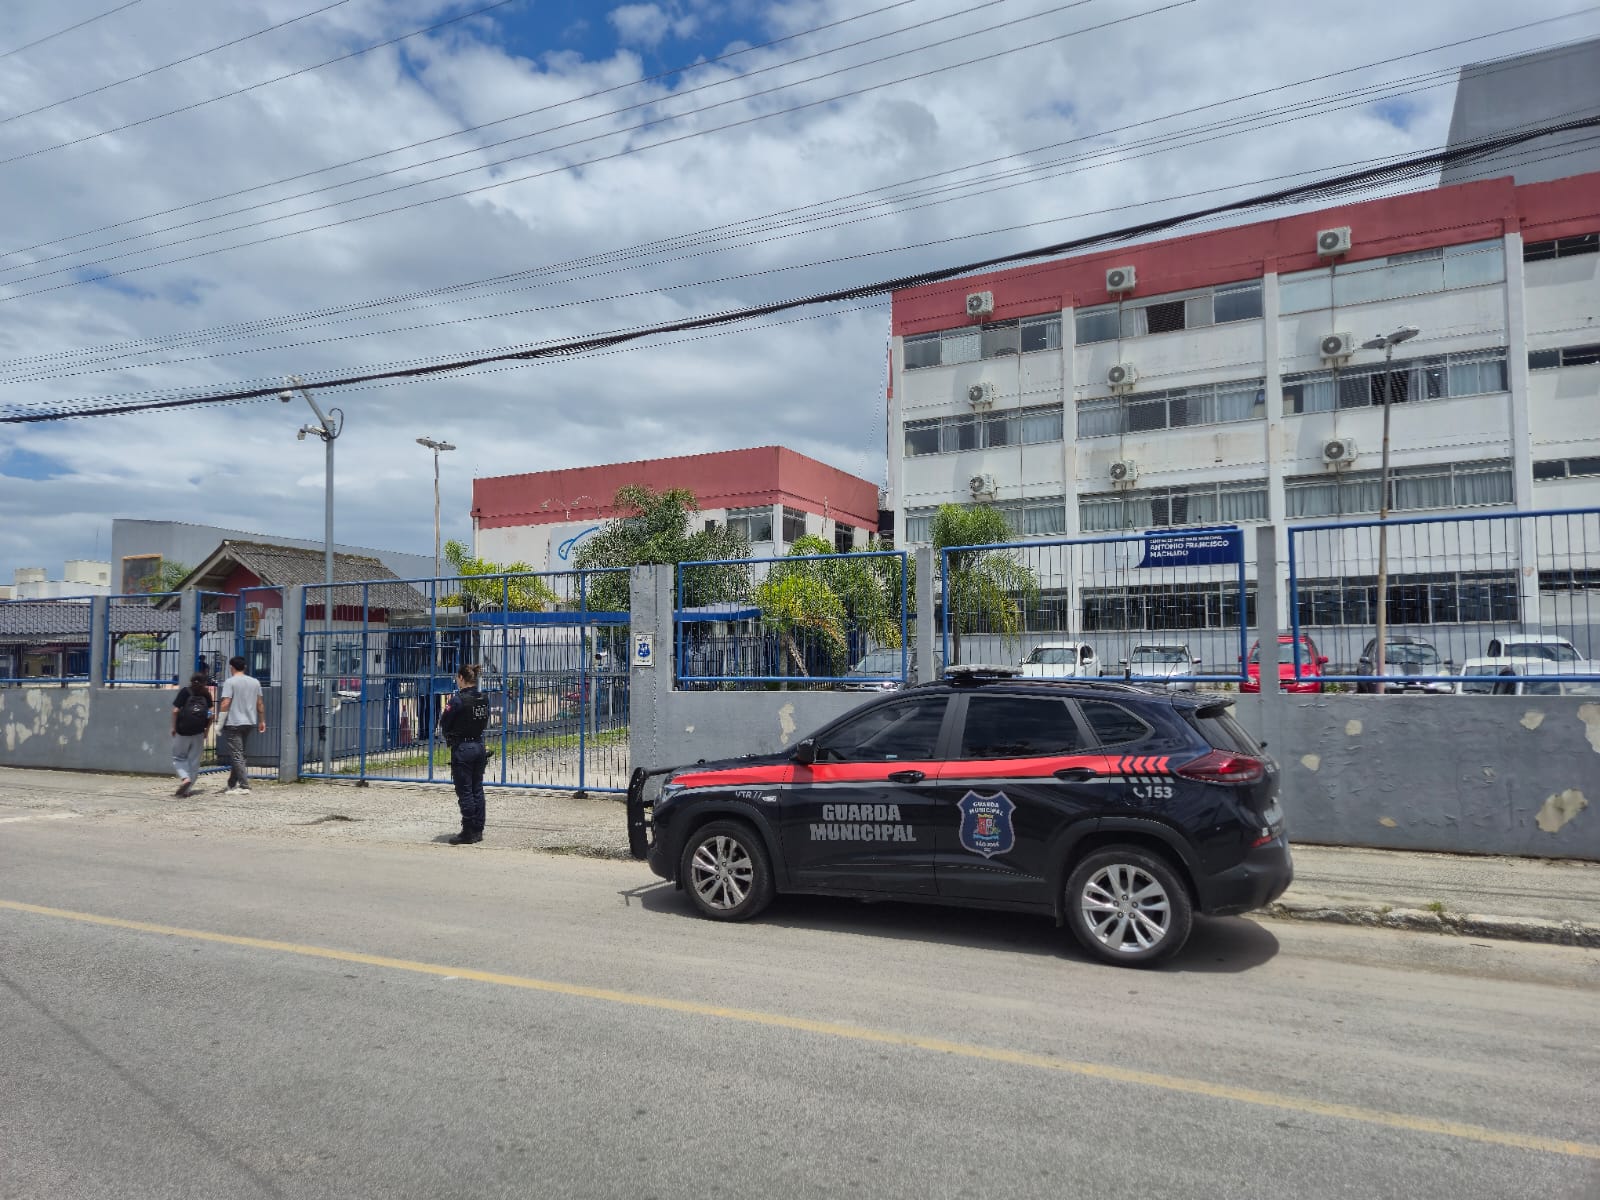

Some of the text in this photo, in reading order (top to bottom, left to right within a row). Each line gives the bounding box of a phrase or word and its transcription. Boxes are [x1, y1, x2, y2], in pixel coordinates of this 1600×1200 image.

[1186, 540, 1229, 549] FRANCISCO
[1150, 550, 1189, 558] MACHADO
[1145, 785, 1173, 799] 153
[822, 804, 901, 821] GUARDA
[969, 807, 1004, 817] MUNICIPAL
[809, 823, 917, 842] MUNICIPAL
